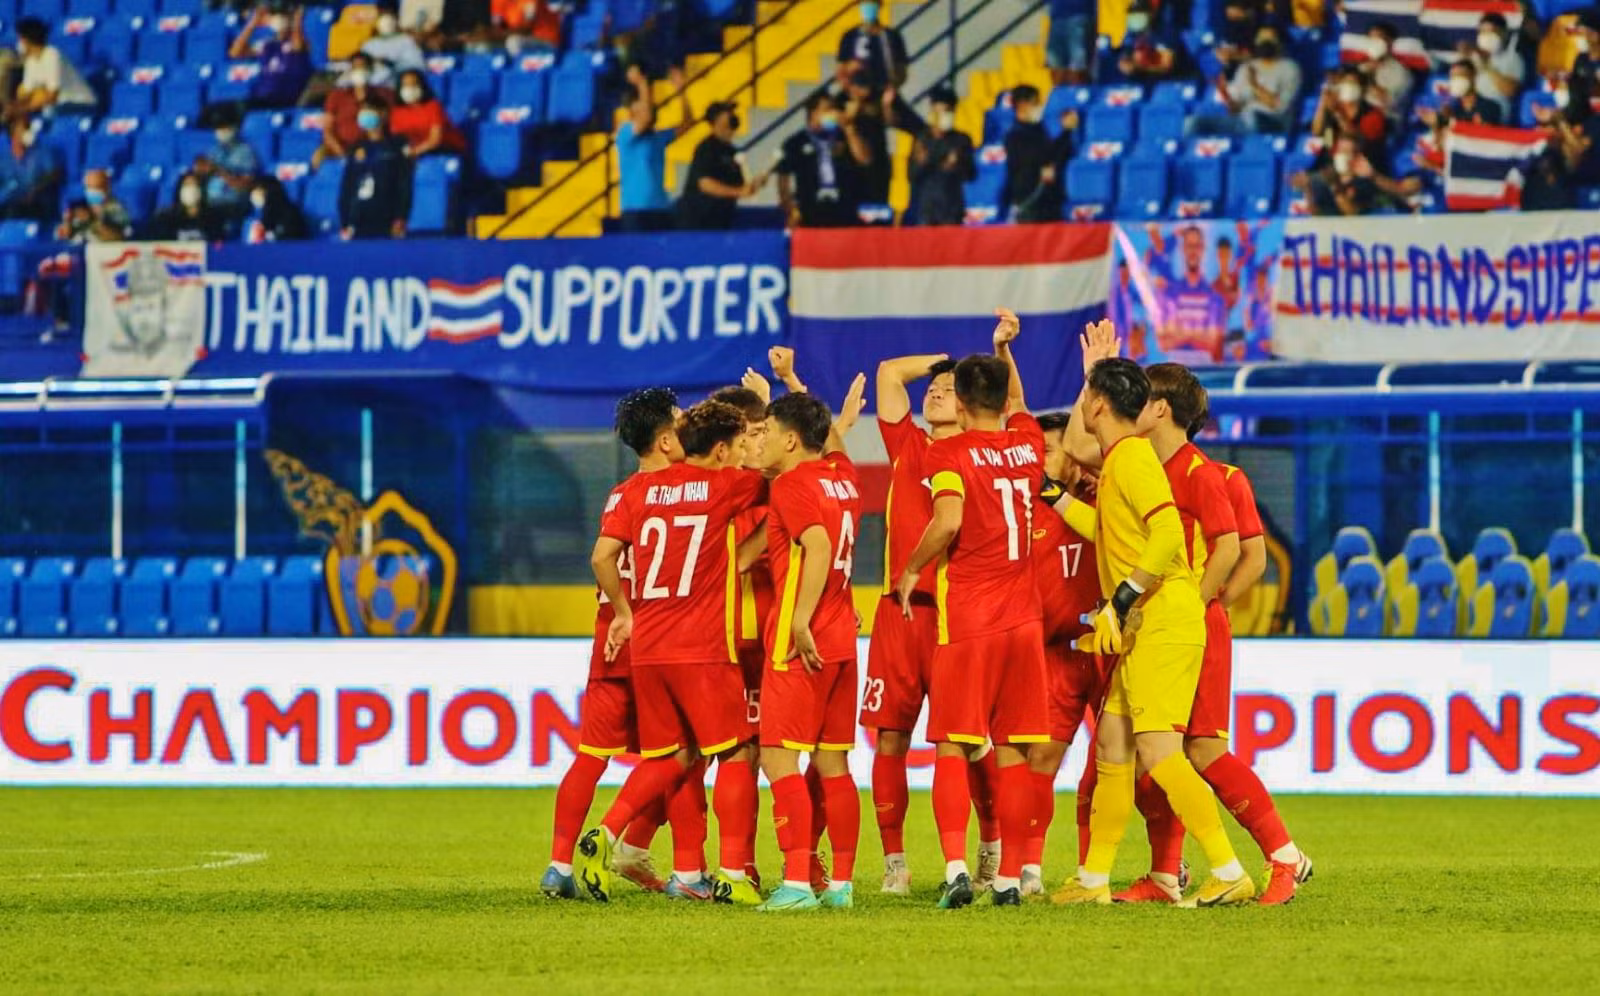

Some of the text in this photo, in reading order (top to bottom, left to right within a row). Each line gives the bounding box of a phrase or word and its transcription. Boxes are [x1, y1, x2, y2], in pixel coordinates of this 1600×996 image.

[203, 264, 786, 354] THAILAND SUPPORTER
[639, 514, 709, 600] 27
[833, 510, 855, 590] 4
[1058, 543, 1082, 578] 17
[861, 676, 885, 713] 23
